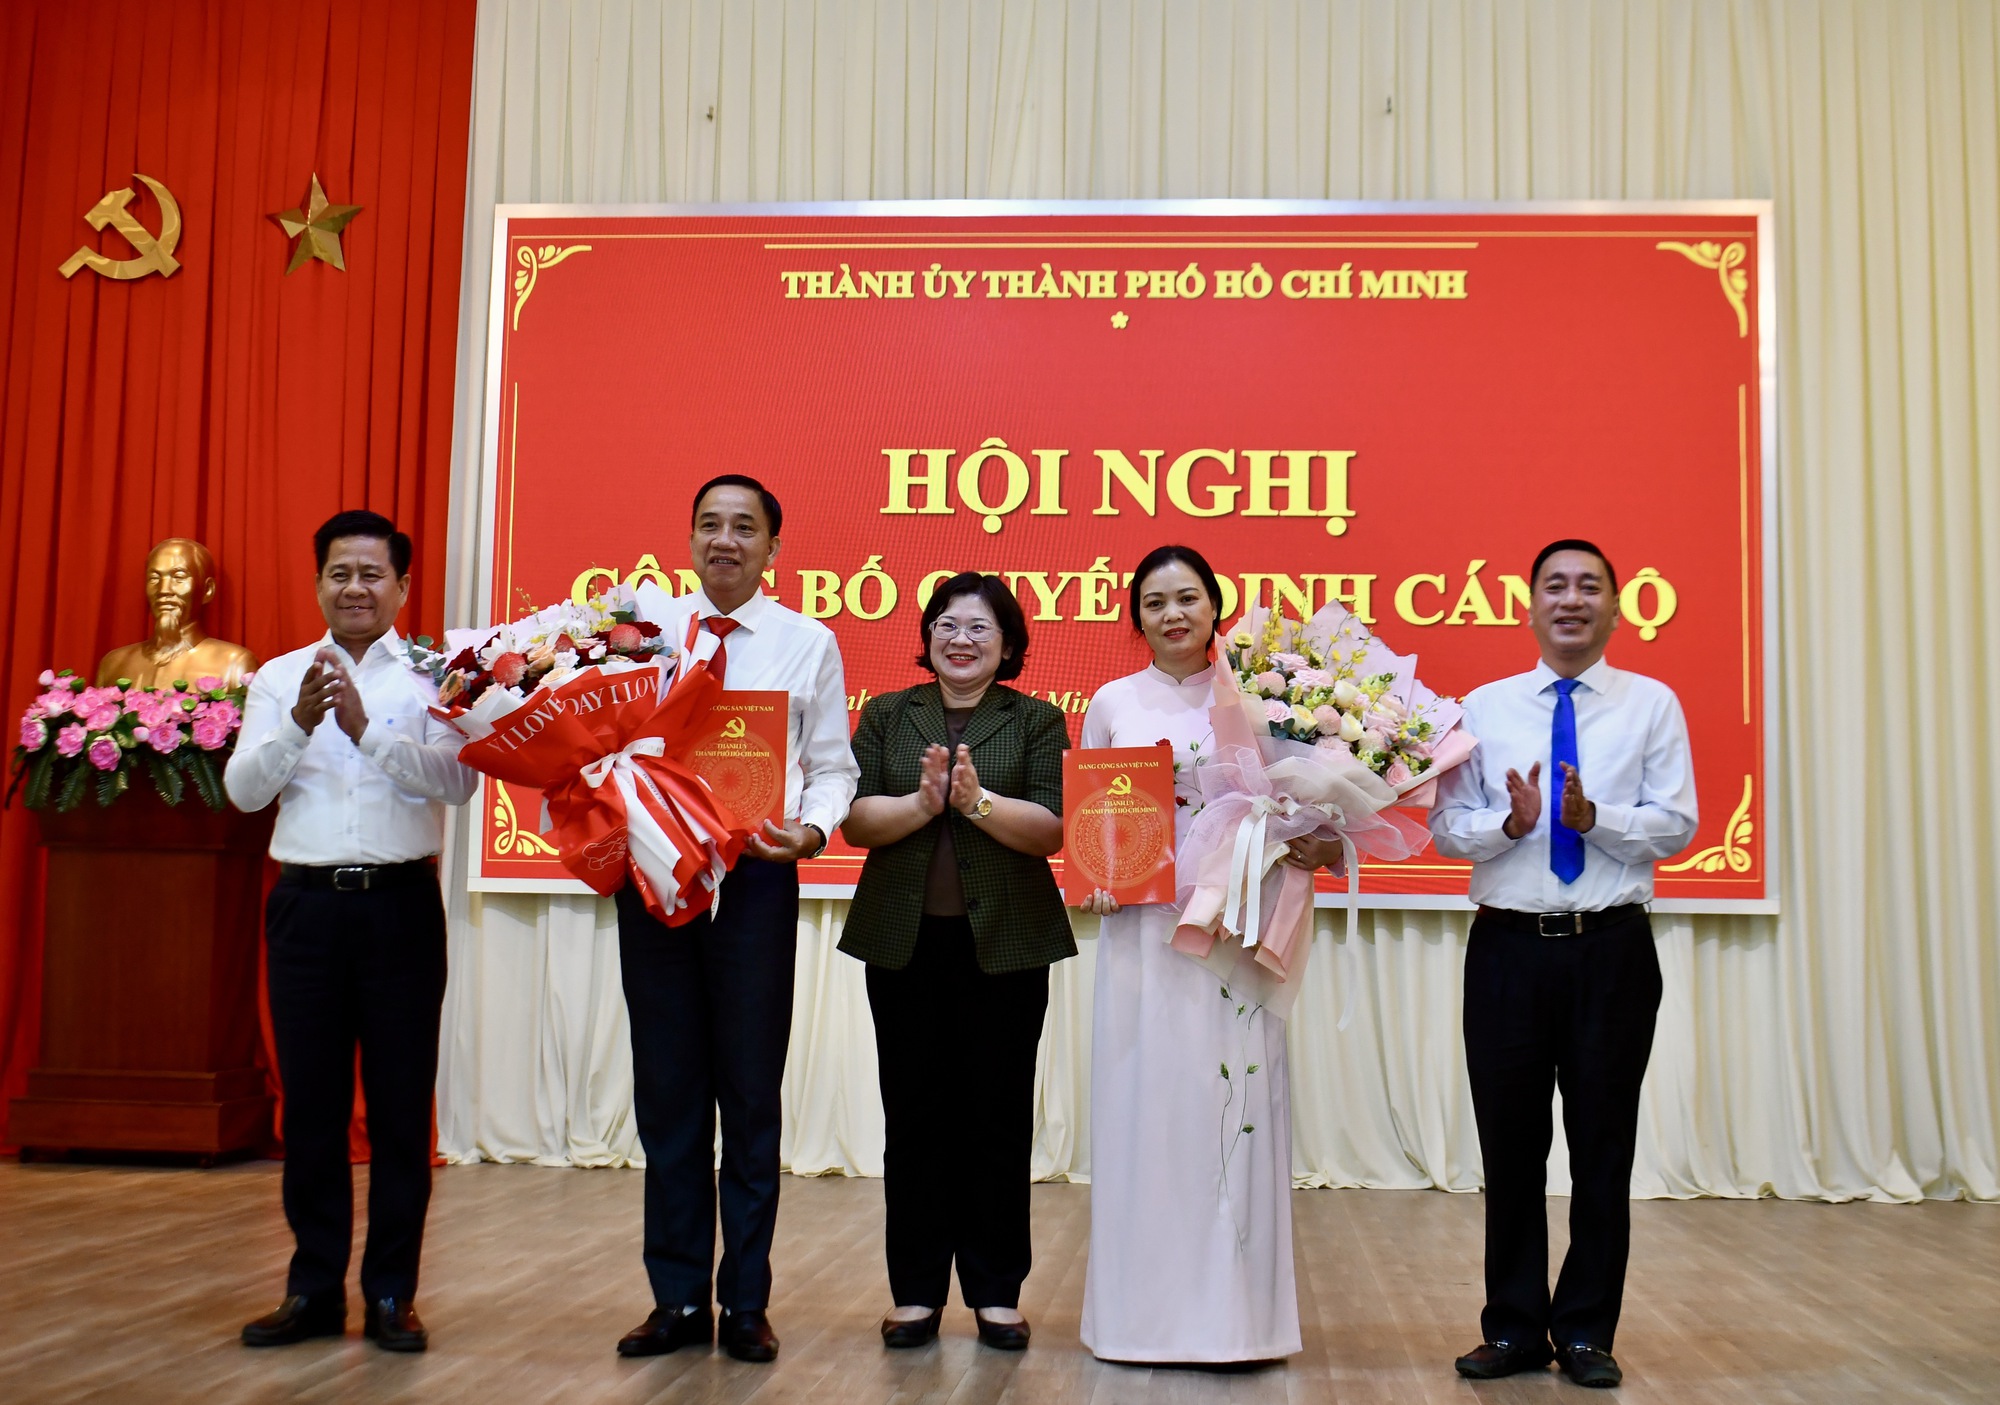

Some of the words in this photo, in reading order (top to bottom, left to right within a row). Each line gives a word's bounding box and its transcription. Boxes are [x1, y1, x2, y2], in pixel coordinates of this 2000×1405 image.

[781, 263, 915, 299] THÀNH
[922, 263, 976, 299] ỦY
[982, 262, 1118, 299] THÀNH
[1280, 262, 1352, 299] CHÍ
[1359, 269, 1468, 299] MINH
[879, 437, 1070, 534] HỘI
[1092, 448, 1357, 536] NGHỊ
[571, 554, 780, 607] CÔ
[797, 555, 899, 621] BỐ
[1619, 566, 1678, 641] Ộ
[509, 692, 566, 743] LOVE
